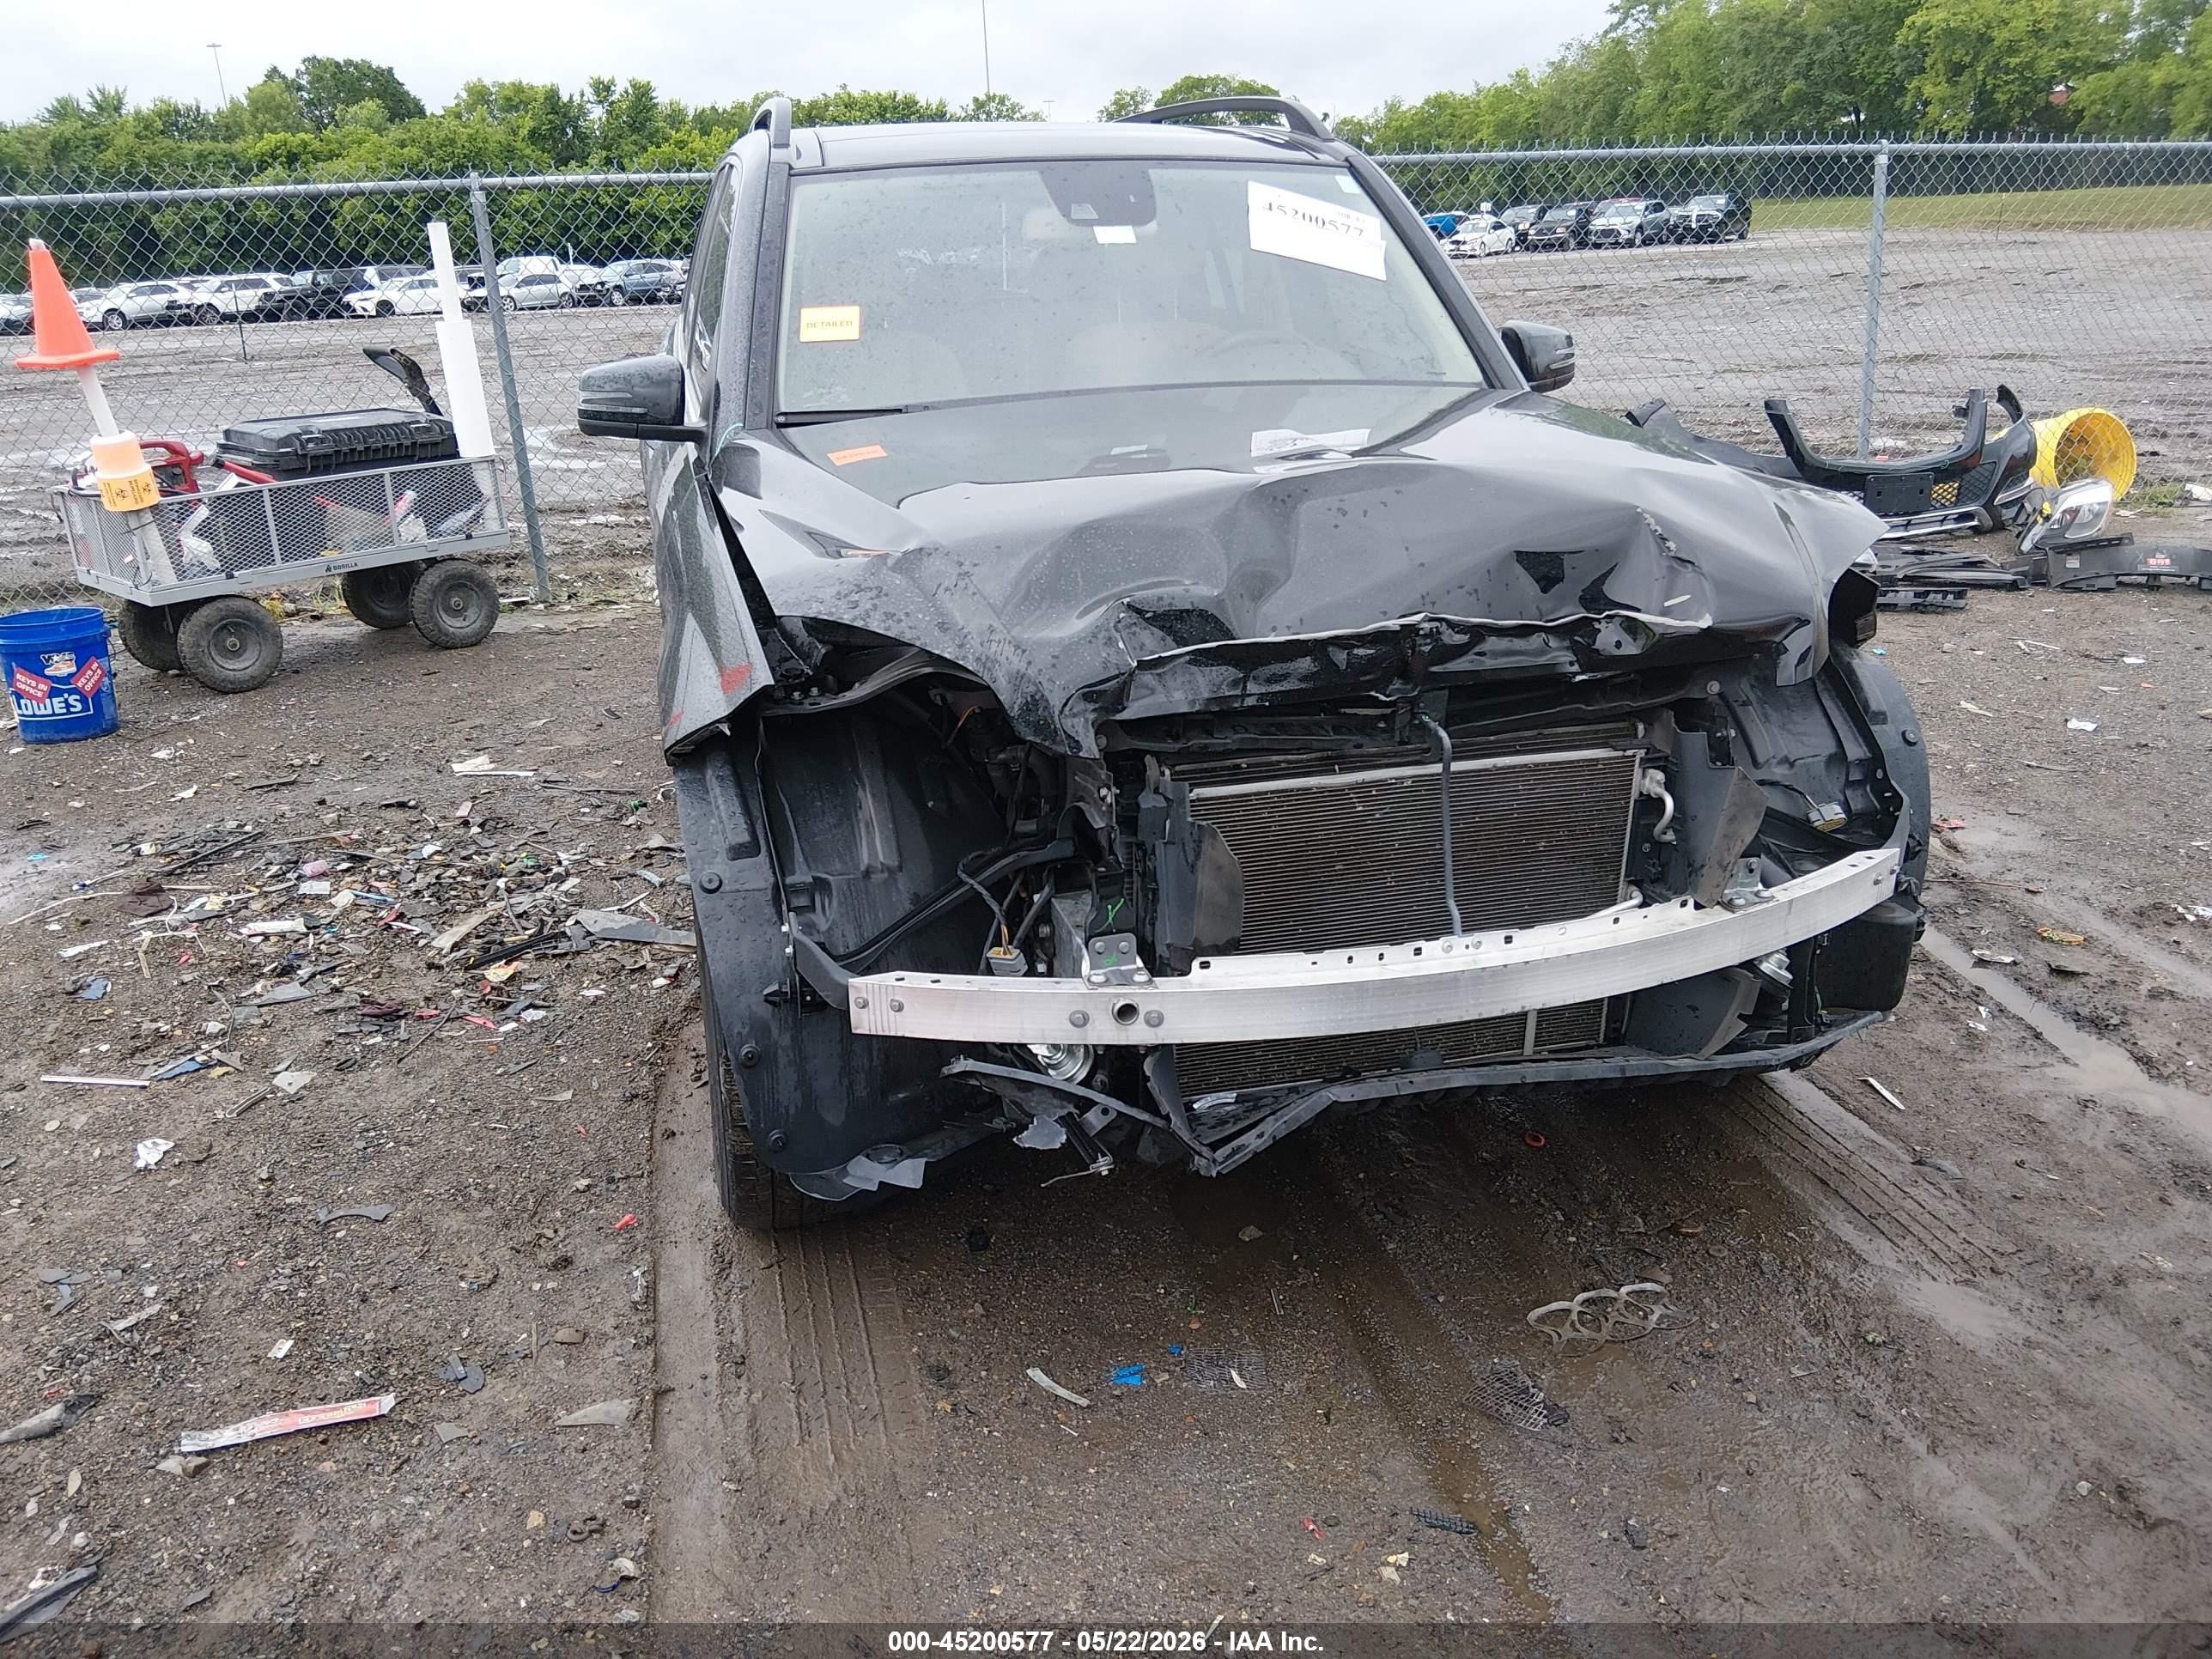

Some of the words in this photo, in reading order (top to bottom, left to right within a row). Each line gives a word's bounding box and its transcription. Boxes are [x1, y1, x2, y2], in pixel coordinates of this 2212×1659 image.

[806, 319, 854, 329] DETAILED
[16, 673, 37, 687] KEYS
[38, 683, 48, 692] IN
[76, 670, 94, 688] KEYS
[84, 668, 102, 691] OFFICE
[16, 682, 44, 698] OFFICE
[12, 693, 83, 715] LOWE'S
